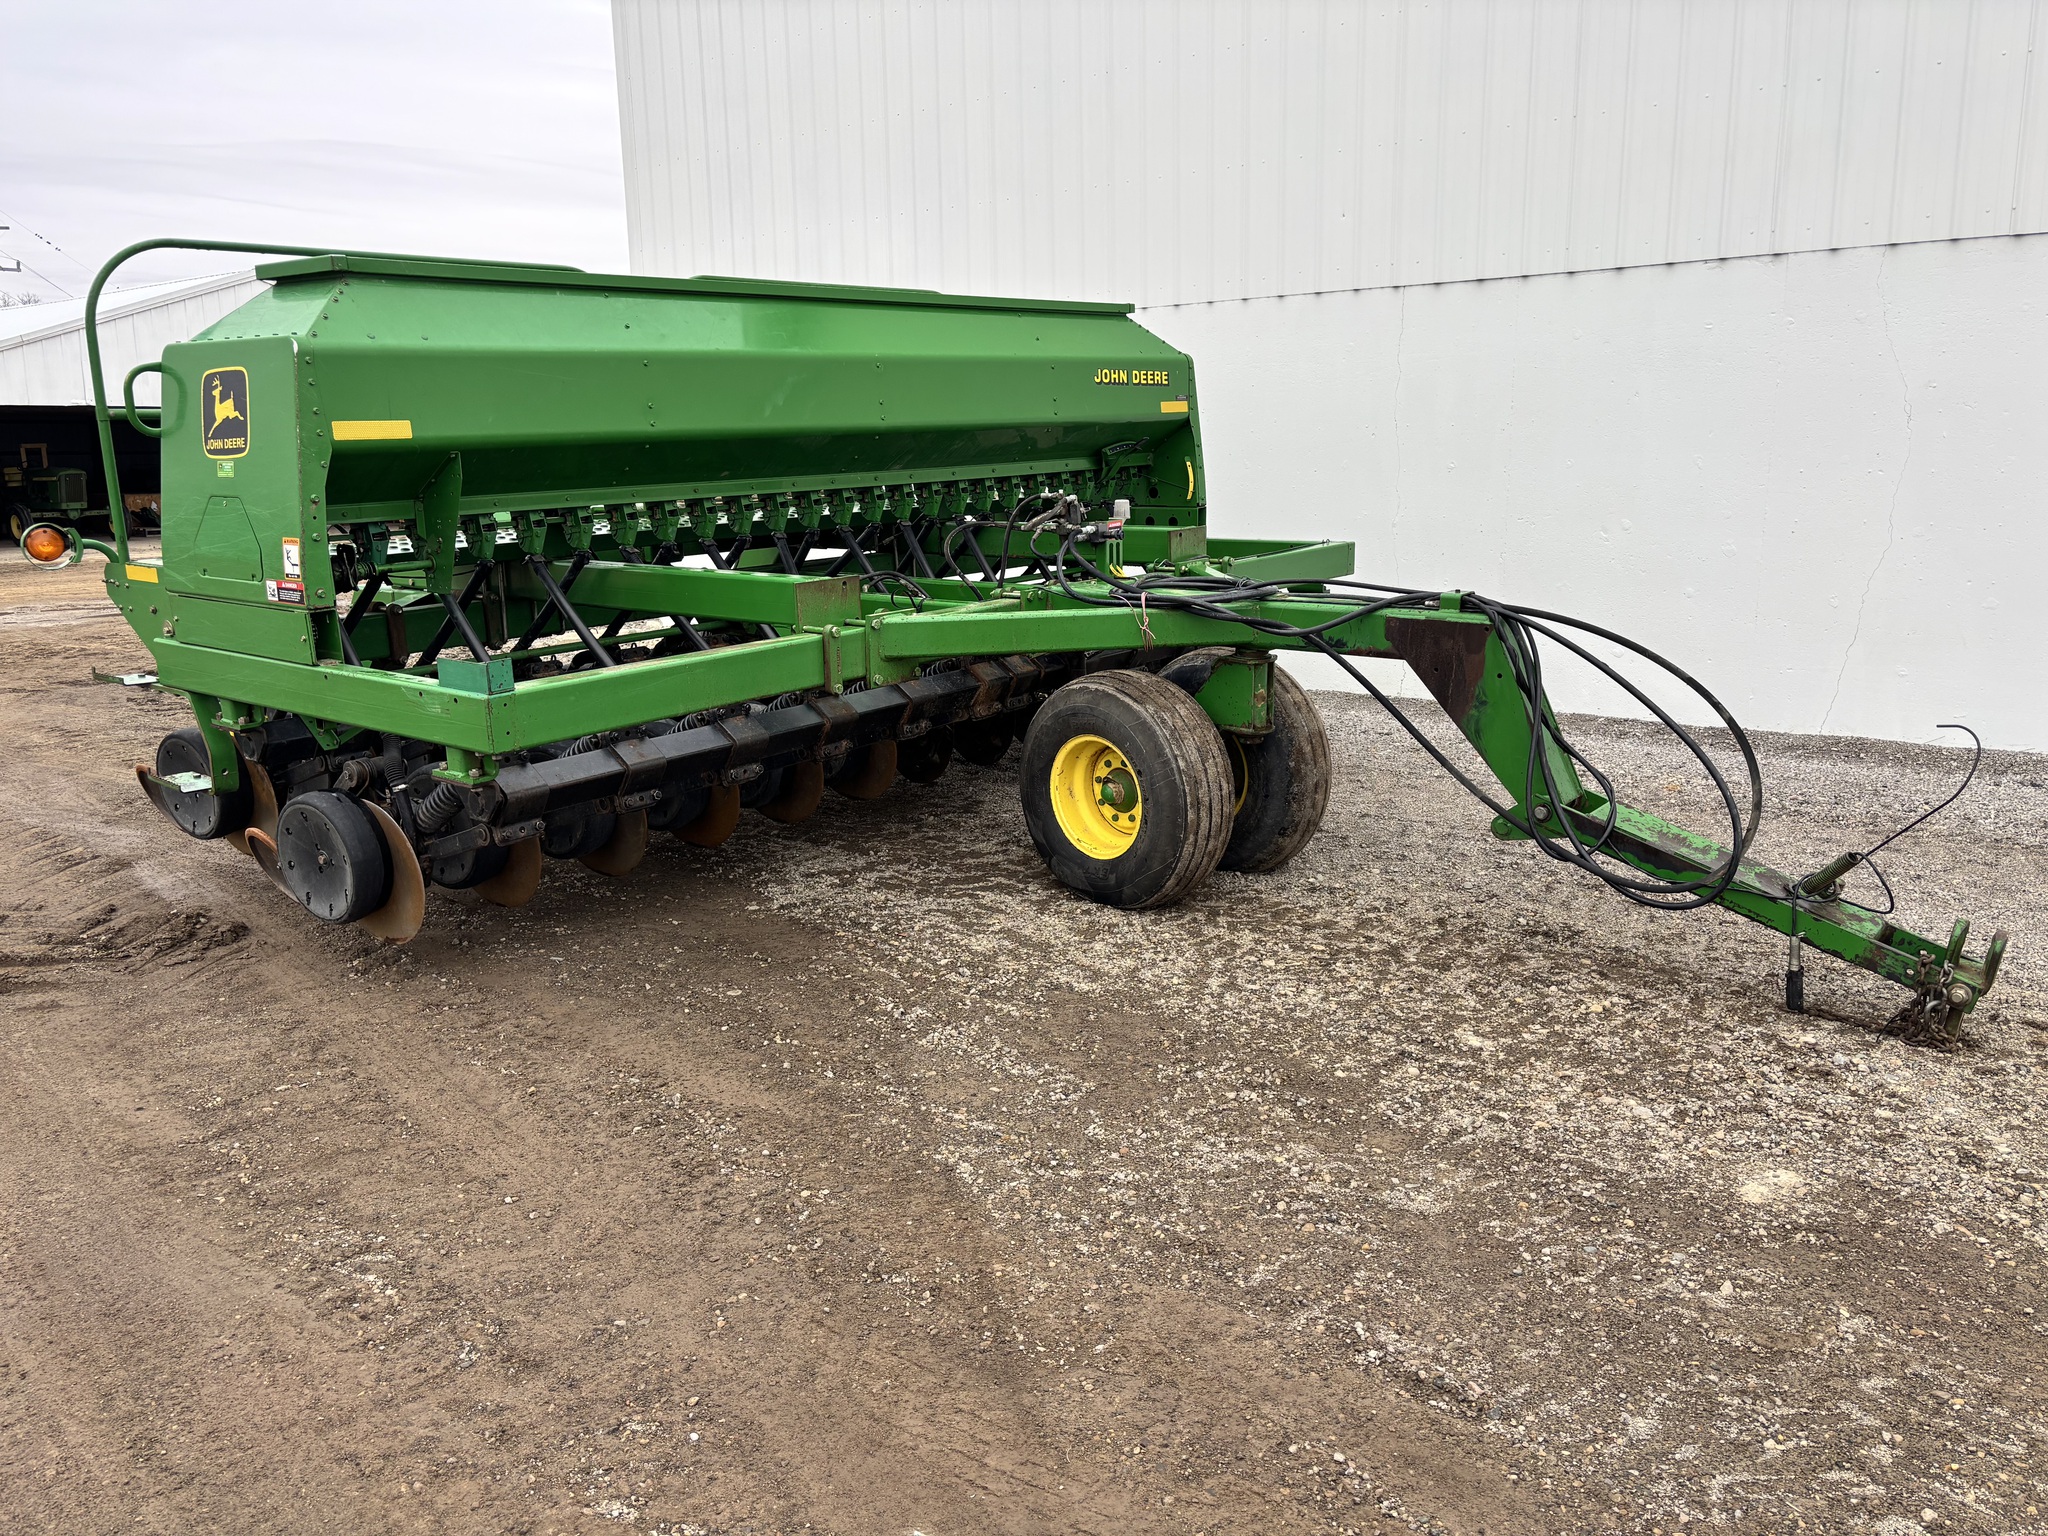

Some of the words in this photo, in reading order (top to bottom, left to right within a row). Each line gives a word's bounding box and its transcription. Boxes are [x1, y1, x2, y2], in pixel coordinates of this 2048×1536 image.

[1094, 369, 1129, 386] JOHN
[1132, 370, 1170, 387] DEERE
[206, 439, 223, 449] JOHN
[224, 438, 246, 449] DEERE
